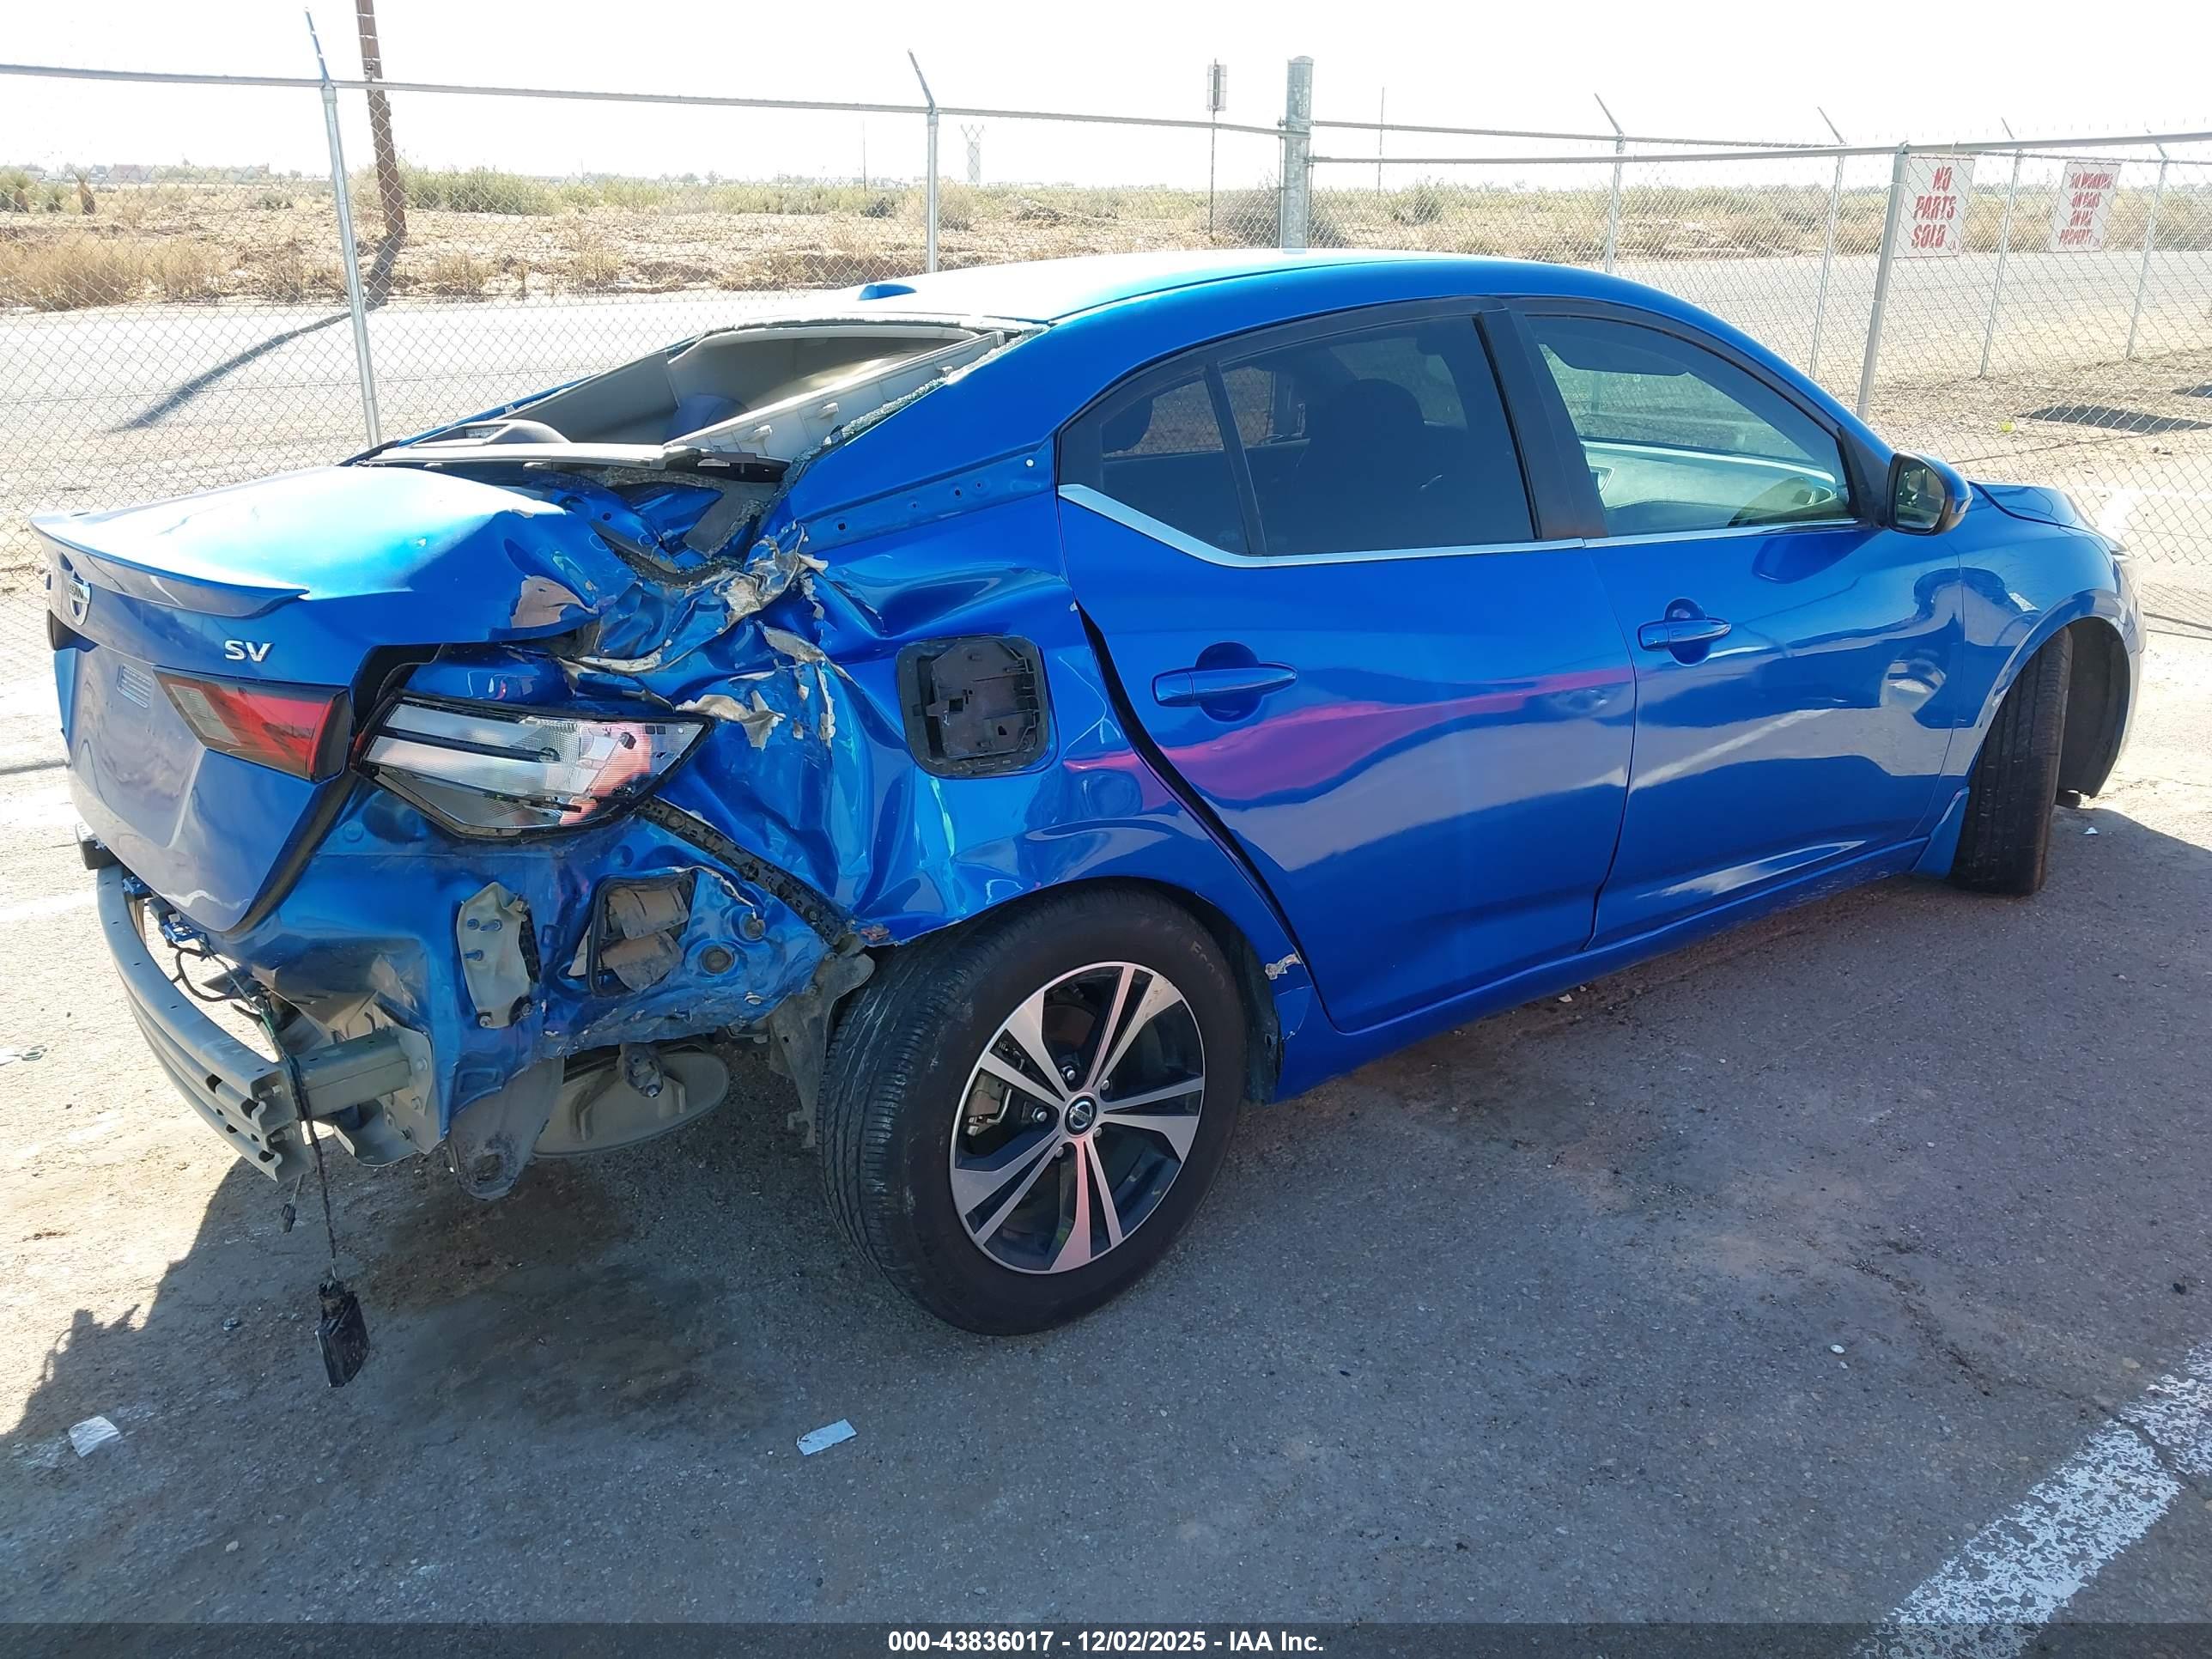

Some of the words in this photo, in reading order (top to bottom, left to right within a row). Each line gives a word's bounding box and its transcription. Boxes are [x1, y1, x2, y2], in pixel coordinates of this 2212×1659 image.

[1932, 166, 1952, 191] NO
[2069, 172, 2081, 189] NO
[2081, 172, 2112, 189] WORKING
[1913, 195, 1957, 220] PARTS
[2072, 191, 2083, 208] ON
[2082, 191, 2101, 208] CARS
[2070, 210, 2081, 227] ON
[1911, 223, 1947, 248] SOLD
[225, 640, 272, 662] SV
